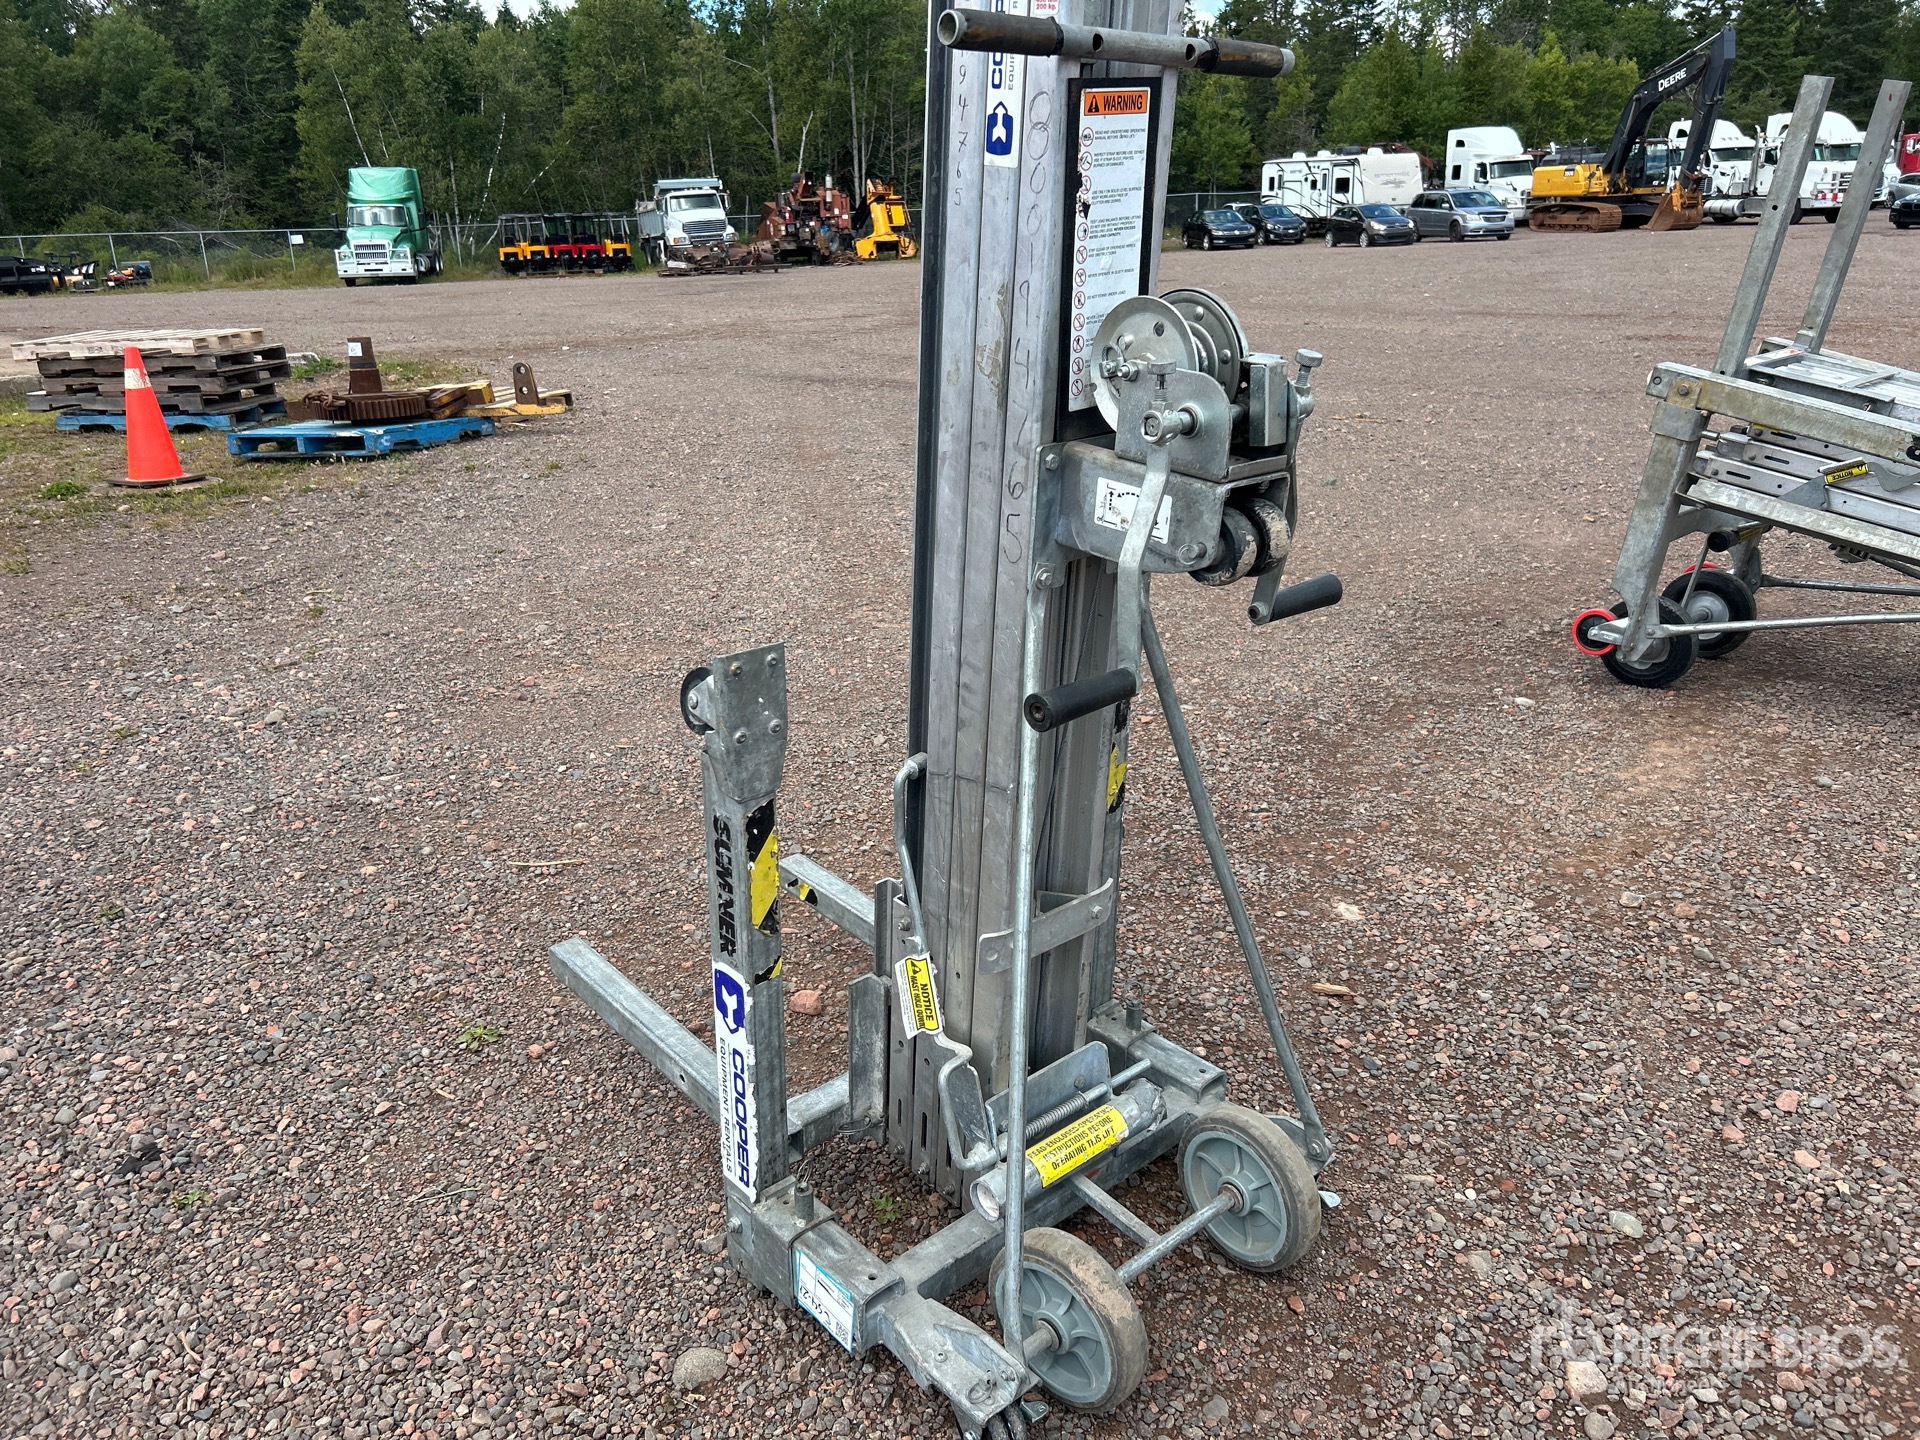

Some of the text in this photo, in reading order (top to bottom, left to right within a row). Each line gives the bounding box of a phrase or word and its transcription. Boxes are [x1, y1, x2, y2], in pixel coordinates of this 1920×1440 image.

[1658, 67, 1687, 92] DEERE
[1103, 95, 1143, 111] WARNING
[1831, 470, 1853, 480] NOTICE
[911, 976, 920, 992] MAST
[914, 993, 922, 1008] HOLD
[920, 983, 934, 1021] NOTICE
[720, 1037, 732, 1174] EQUIPMENT RENTALS
[732, 1047, 750, 1188] COOPER
[1043, 1116, 1113, 1162] INSTRUCTIONS BEFORE
[1045, 1125, 1080, 1149] ENCLOSED
[1051, 1126, 1116, 1171] OPERATING THIS LIFT
